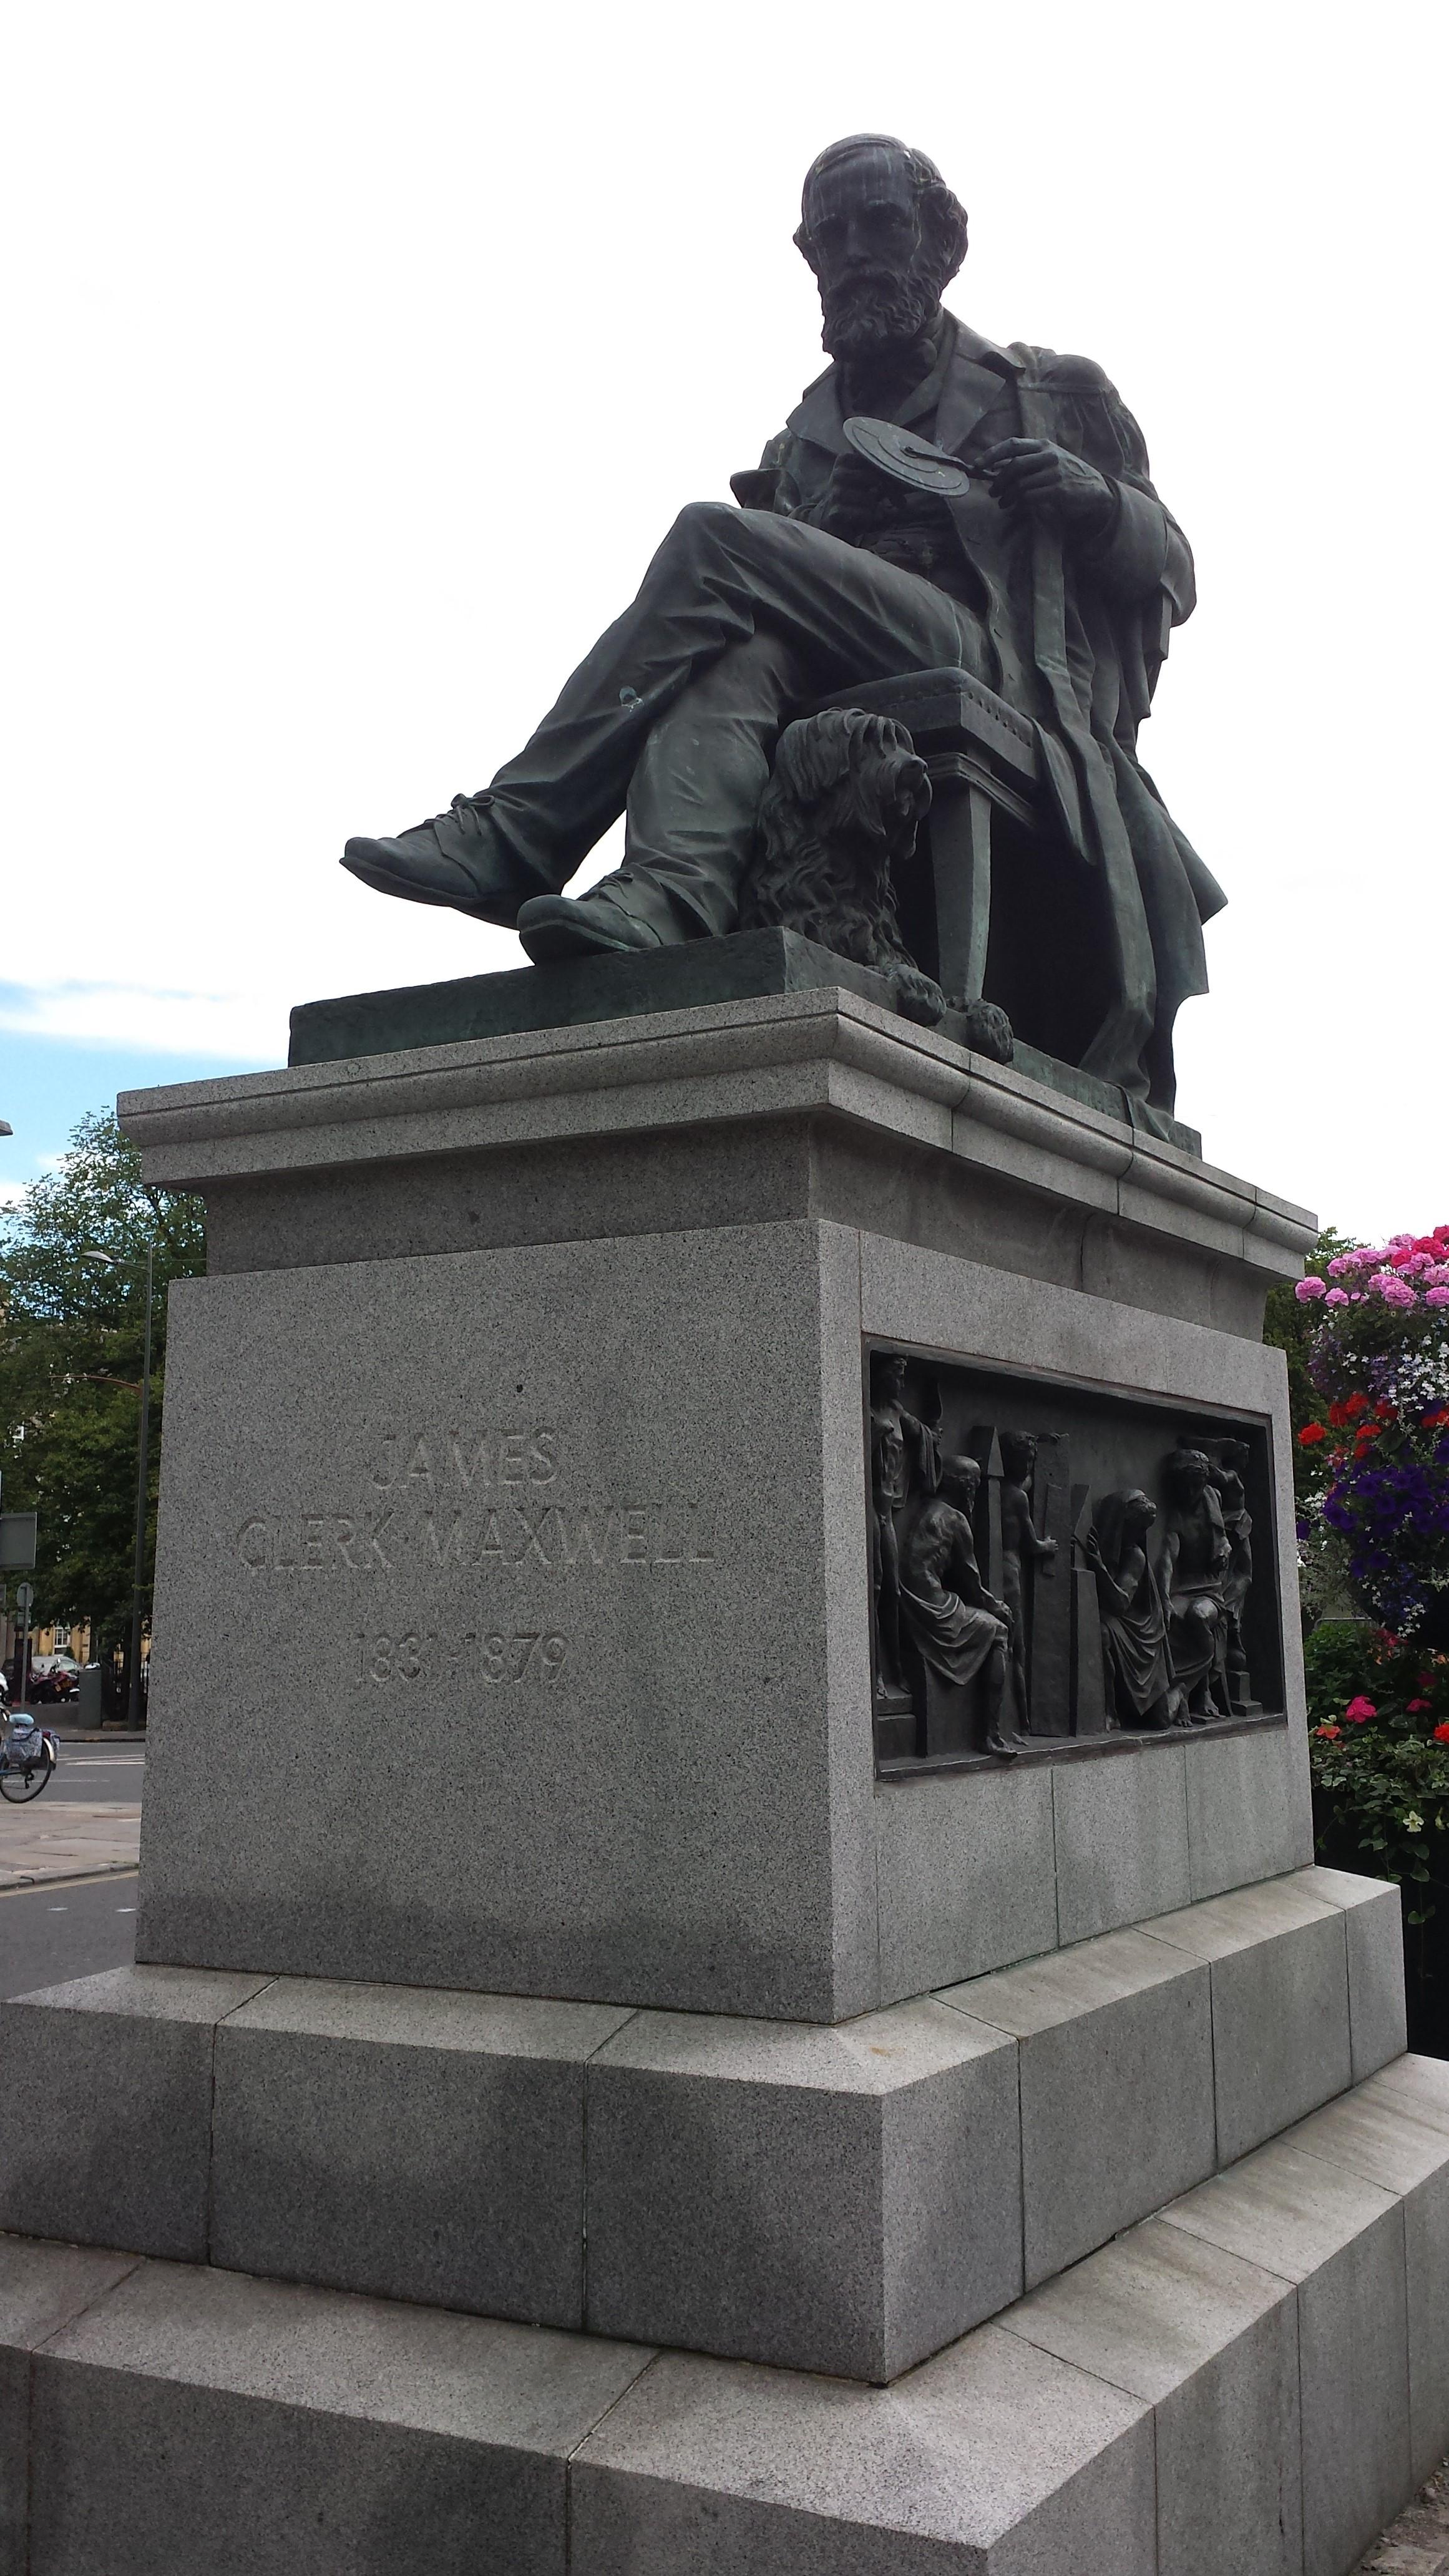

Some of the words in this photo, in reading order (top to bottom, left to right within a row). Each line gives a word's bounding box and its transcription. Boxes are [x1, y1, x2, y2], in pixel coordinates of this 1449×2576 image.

[373, 1426, 559, 1490] JAMES
[236, 1511, 394, 1569] CLERK
[416, 1503, 715, 1565] MAXWELL
